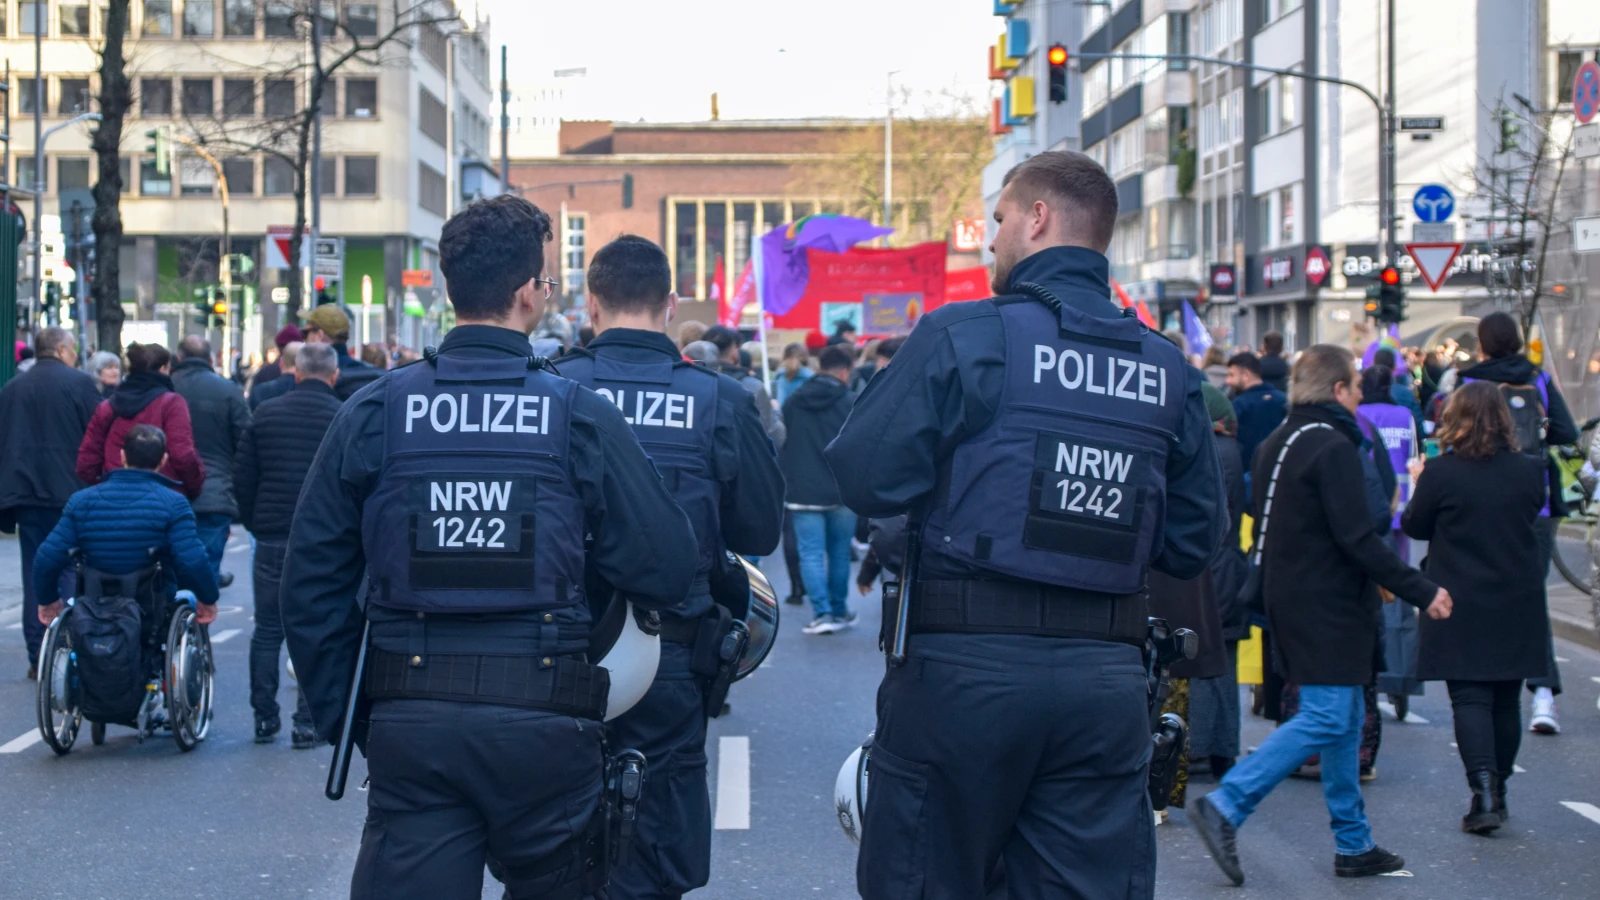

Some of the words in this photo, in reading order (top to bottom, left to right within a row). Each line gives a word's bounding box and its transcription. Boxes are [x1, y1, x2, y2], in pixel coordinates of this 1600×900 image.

[1034, 344, 1167, 406] POLIZEI
[405, 393, 550, 435] POLIZEI
[1055, 442, 1134, 483] NRW
[430, 481, 513, 511] NRW
[1056, 479, 1123, 519] 1242
[432, 516, 506, 548] 1242
